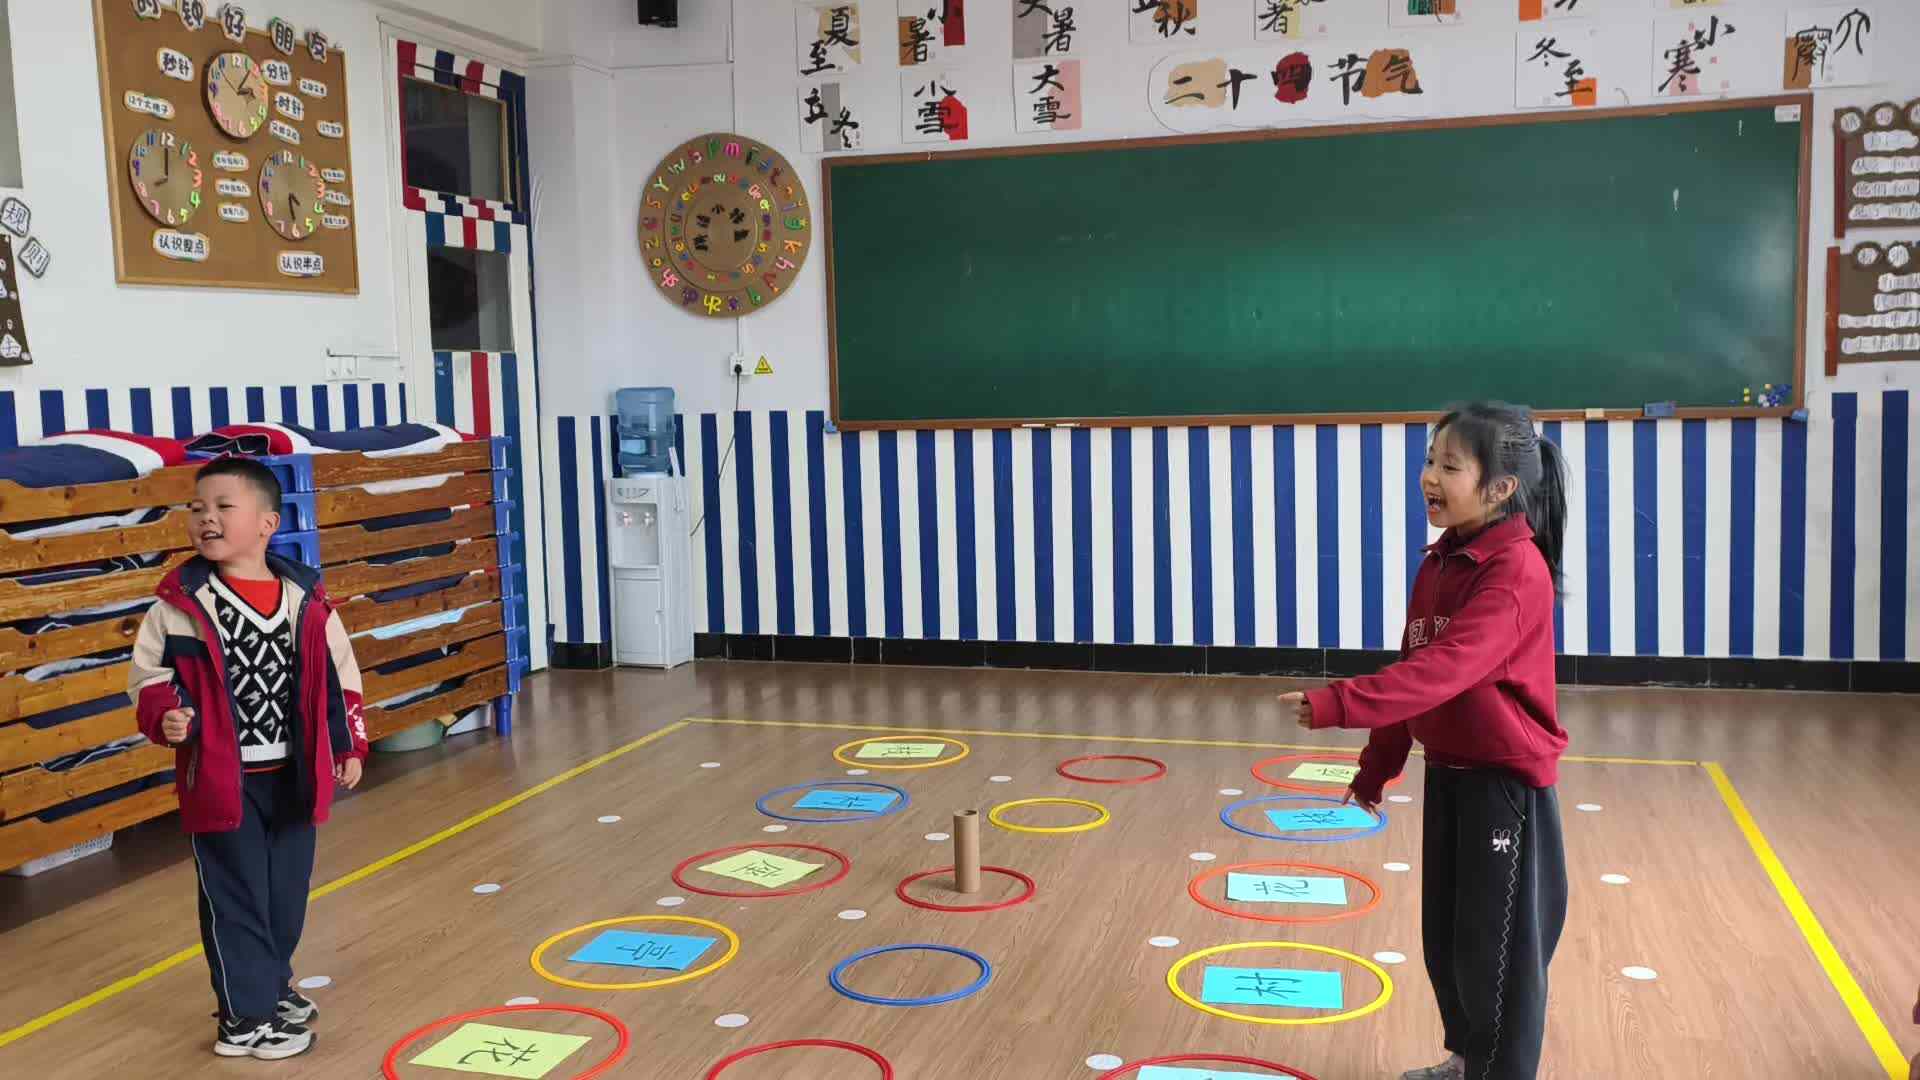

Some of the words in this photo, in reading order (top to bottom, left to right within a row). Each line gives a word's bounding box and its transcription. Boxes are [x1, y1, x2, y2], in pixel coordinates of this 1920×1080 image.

[800, 5, 859, 76] 夏至
[1658, 15, 1737, 93] 小寒
[163, 52, 190, 76] 秒针
[266, 62, 289, 81] 分针
[1526, 36, 1595, 98] 冬至
[1164, 51, 1424, 111] 二十四节气
[1029, 64, 1072, 125] 大雪
[278, 95, 302, 116] 时针
[913, 80, 958, 135] 小雪
[804, 87, 859, 149] 立冬
[160, 131, 175, 147] 12
[186, 151, 197, 166] 2
[282, 149, 293, 164] 12
[723, 142, 742, 157] m
[193, 169, 202, 187] 3
[314, 178, 325, 199] 3
[150, 199, 161, 216] 7
[190, 191, 201, 208] 4
[314, 202, 325, 214] 4
[166, 208, 176, 225] 6
[179, 208, 189, 223] 5
[305, 216, 315, 233] 5
[292, 223, 301, 238] 6
[159, 234, 204, 254] 认识整点
[784, 239, 803, 254] k
[281, 256, 321, 271] 认识半点
[729, 859, 782, 878] 座
[1252, 879, 1310, 898] 花
[614, 940, 676, 962] 亭
[1233, 971, 1303, 1000] 村
[456, 1036, 541, 1068] 花
